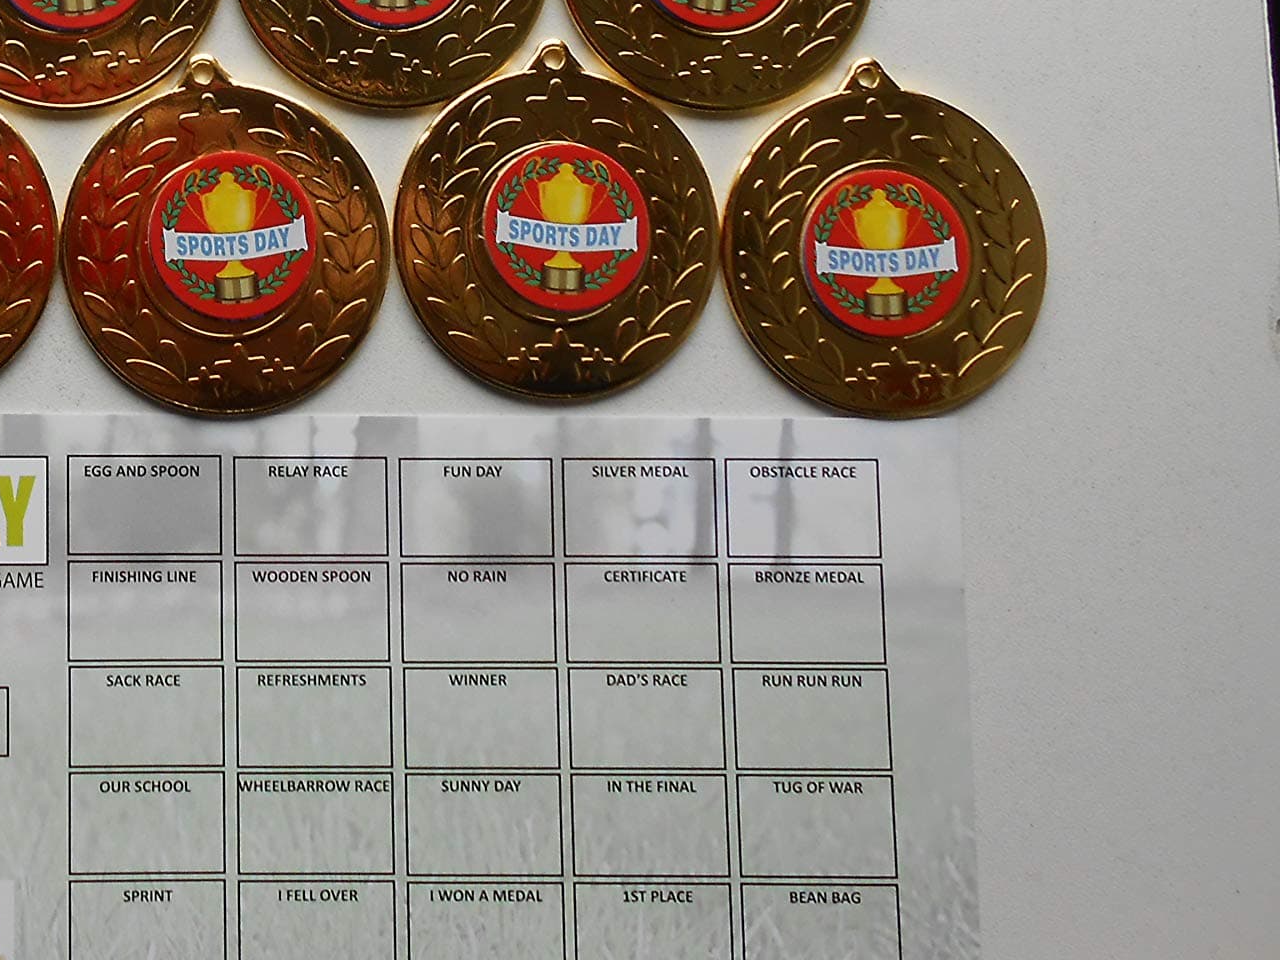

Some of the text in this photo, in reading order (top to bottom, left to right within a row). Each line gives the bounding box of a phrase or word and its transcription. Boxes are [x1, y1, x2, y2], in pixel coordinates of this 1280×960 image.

[510, 219, 623, 247] SPORTS DAY
[176, 228, 289, 257] SPORTS DAY
[829, 247, 941, 273] SPORTS DAY
[84, 464, 200, 478] EGG AND SPOON
[268, 465, 349, 478] RELAY RACE
[441, 464, 503, 479] FUN DAY
[591, 464, 690, 478] SILVER MEDAL
[749, 464, 857, 479] OBSTACLE RACE
[92, 570, 197, 584] FINISHING LINE
[251, 568, 371, 584] WOODEN SPOON
[447, 570, 507, 583] NO RAIN
[602, 569, 689, 584] CERTIFICATE
[754, 570, 865, 584] BRONZE MEDAL
[106, 673, 181, 688] SACK RACE
[257, 673, 367, 687] REFRESHMENTS
[448, 672, 508, 687] WINNER
[606, 672, 689, 687] DAD'S RACE
[761, 674, 863, 689] RUN RUN RUN
[99, 779, 192, 794] OUR SCHOOL
[237, 778, 390, 793] WHEELBARROW RACE
[441, 779, 522, 793] SUNNY DAY
[607, 780, 698, 794] IN THE FINAL
[771, 780, 864, 795] TUG OF WAR
[123, 889, 174, 903] SPRINT
[286, 888, 317, 903] FELL
[319, 888, 359, 904] OVER
[437, 887, 475, 903] WON
[478, 889, 490, 903] A
[492, 888, 544, 903] MEDAL
[621, 889, 694, 904] 1ST PLACE
[789, 891, 862, 905] BEAN BAG
